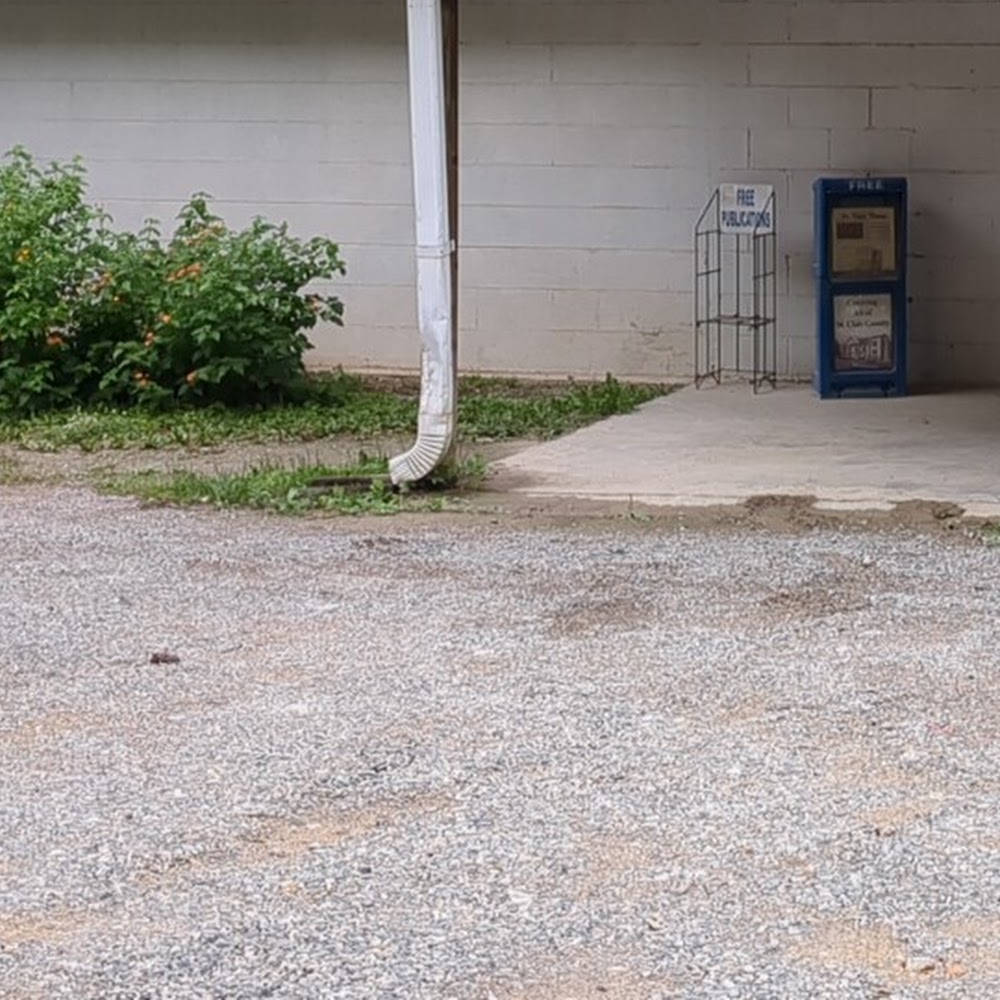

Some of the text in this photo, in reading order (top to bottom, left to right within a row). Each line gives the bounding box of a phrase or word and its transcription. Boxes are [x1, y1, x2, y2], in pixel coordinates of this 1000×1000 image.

[848, 179, 884, 192] FREE
[736, 188, 755, 206] FREE
[721, 210, 771, 229] PUBLICATIONS
